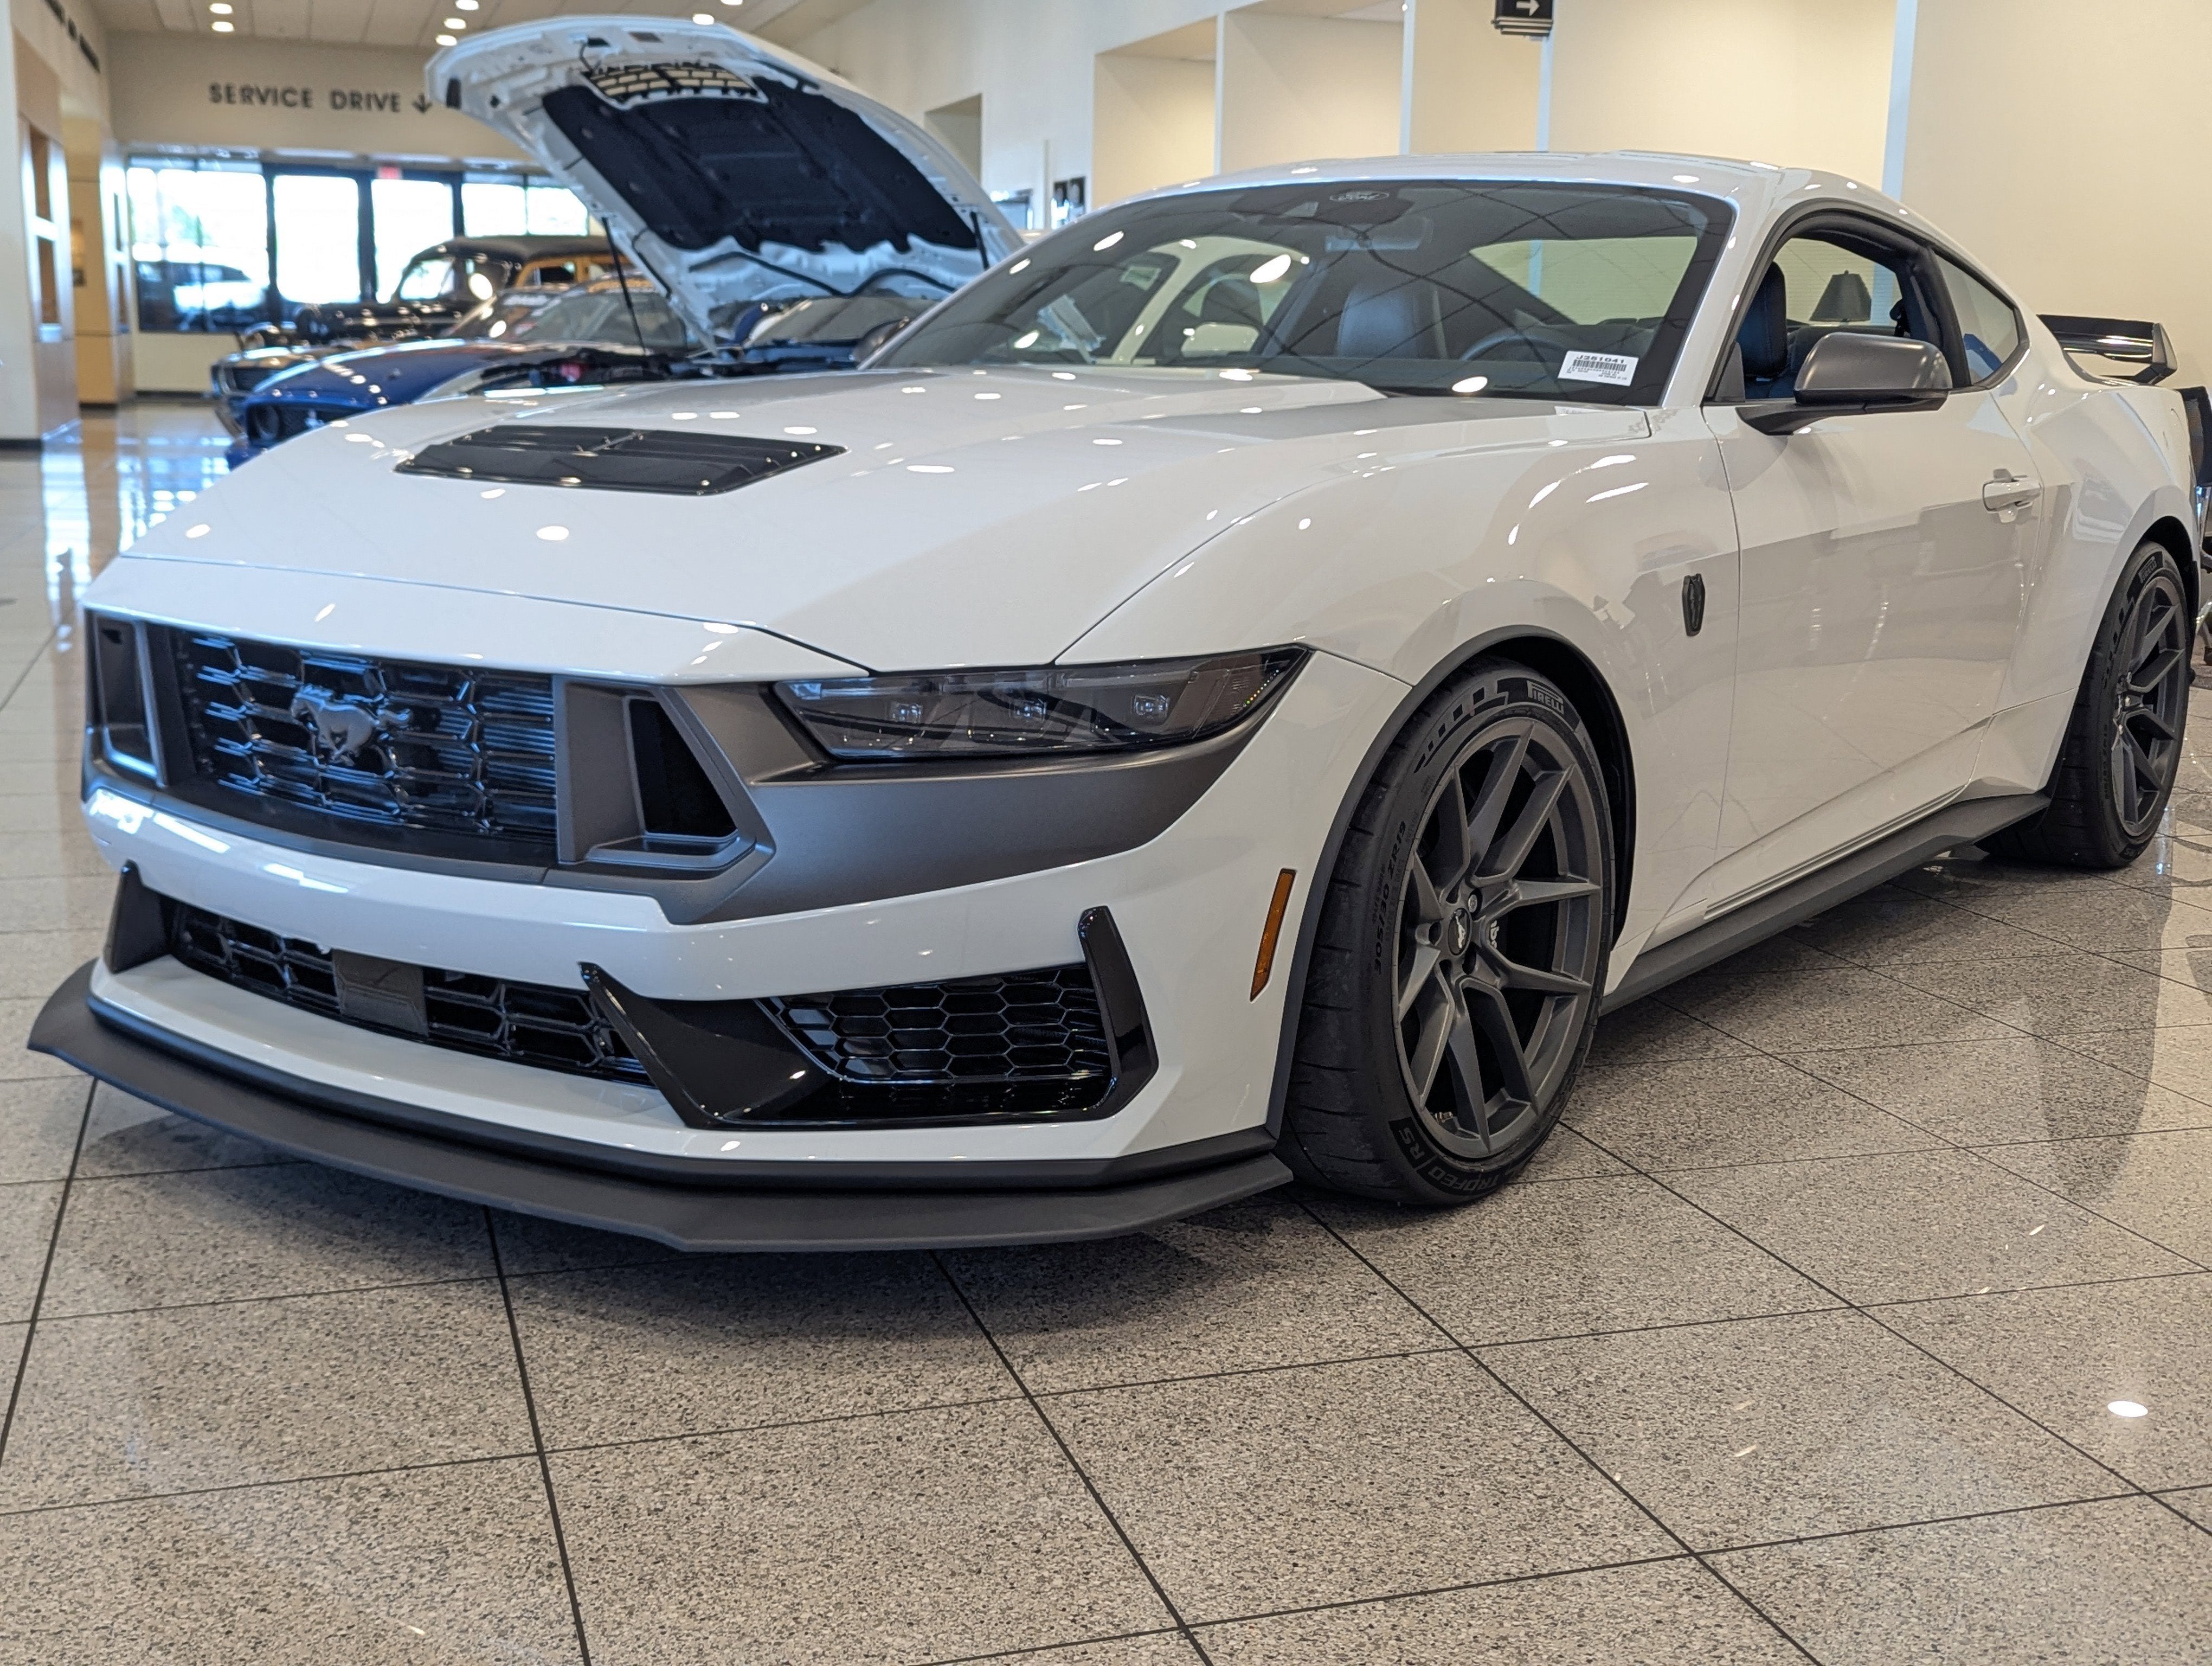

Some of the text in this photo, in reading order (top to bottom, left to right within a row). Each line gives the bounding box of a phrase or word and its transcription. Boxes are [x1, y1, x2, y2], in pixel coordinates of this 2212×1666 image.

[209, 82, 400, 112] SERVICE DRIVE
[1527, 680, 1564, 715] PIRELLI
[1387, 821, 1406, 880] ZR19
[1398, 1127, 1500, 1191] TROFEO RS
